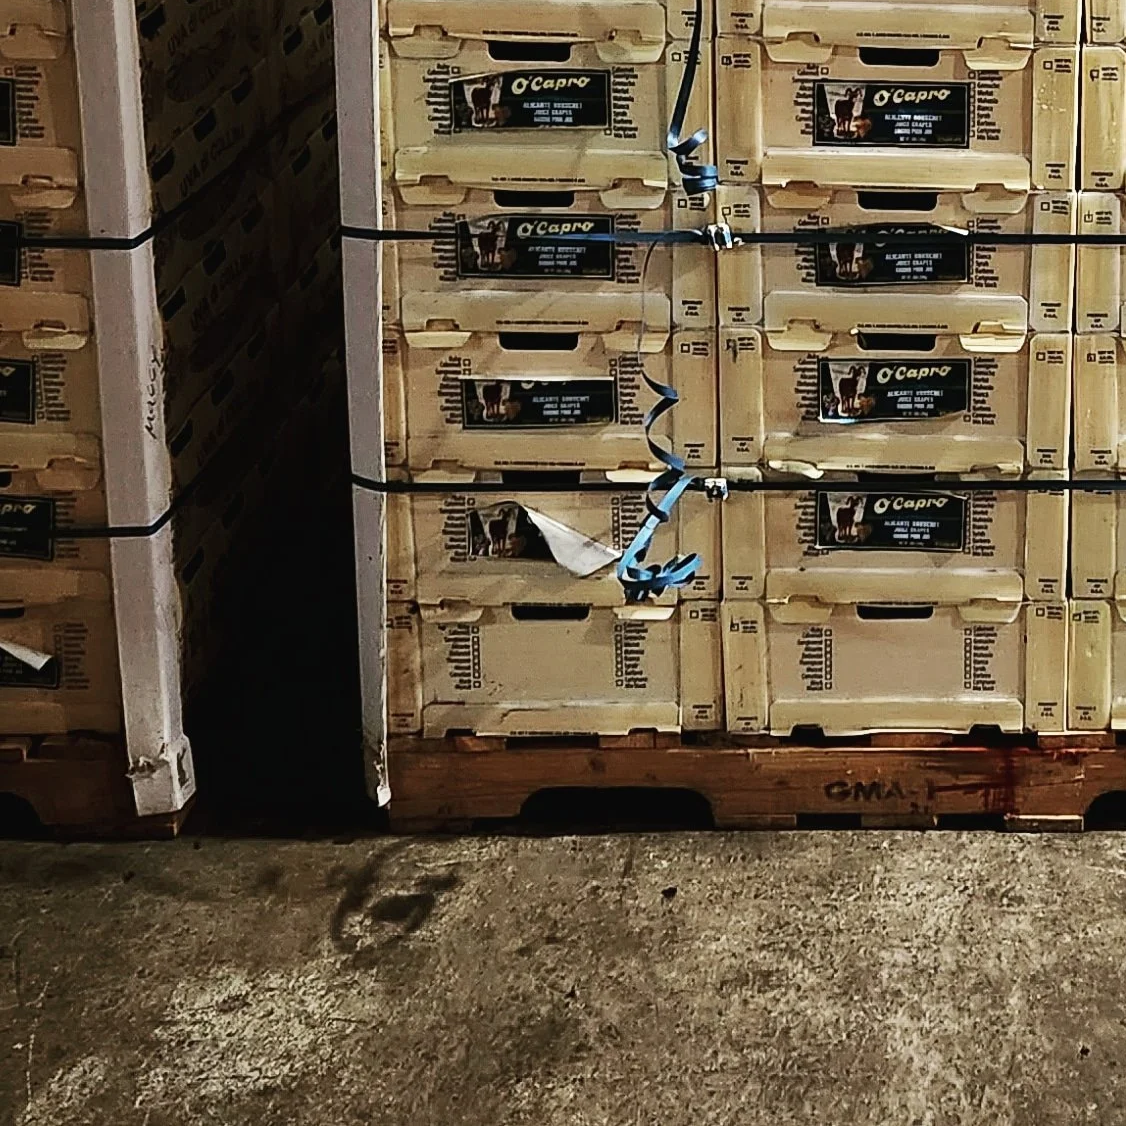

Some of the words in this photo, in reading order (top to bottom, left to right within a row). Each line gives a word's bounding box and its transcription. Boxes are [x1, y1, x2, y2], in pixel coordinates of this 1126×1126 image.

[511, 77, 590, 94] O'Capro
[873, 90, 951, 106] O'Capro
[517, 222, 594, 237] O'Capro
[876, 366, 952, 384] O'Capro
[874, 497, 948, 514] O'Capro
